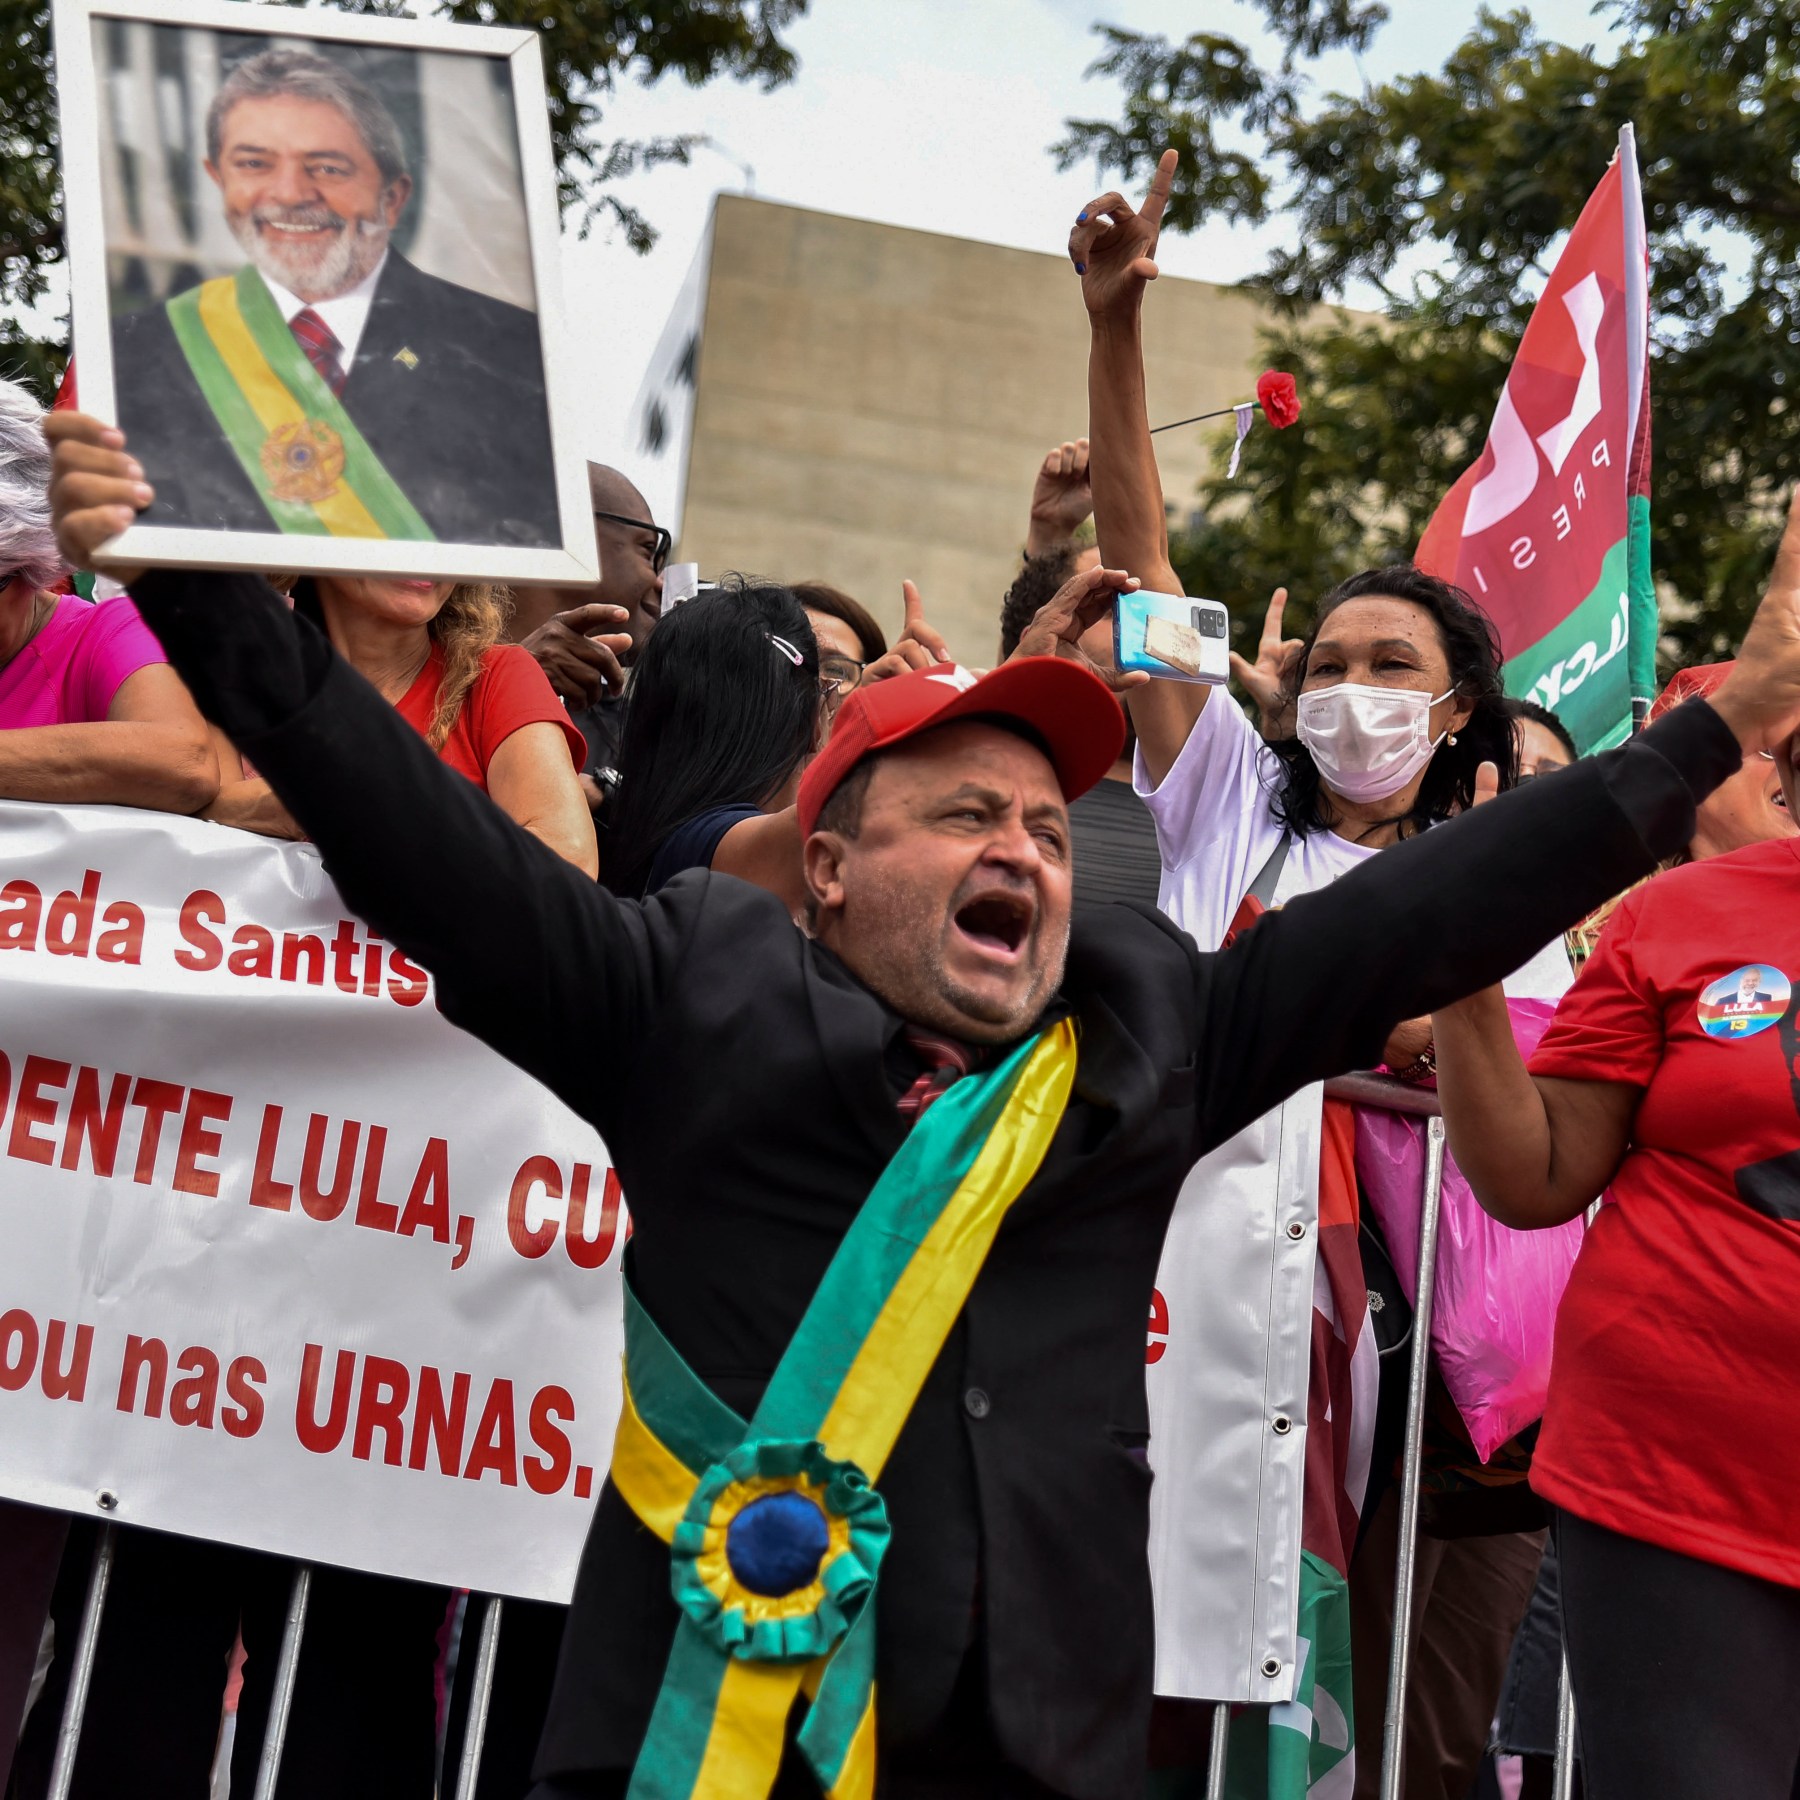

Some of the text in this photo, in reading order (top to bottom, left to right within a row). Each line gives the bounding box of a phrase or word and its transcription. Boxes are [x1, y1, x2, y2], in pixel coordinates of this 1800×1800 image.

[0, 868, 146, 965] ada
[1723, 1002, 1764, 1014] LULA
[1730, 1019, 1749, 1031] 13
[248, 1102, 476, 1271] LULA,
[0, 1308, 593, 1499] ou nas URNAS.
